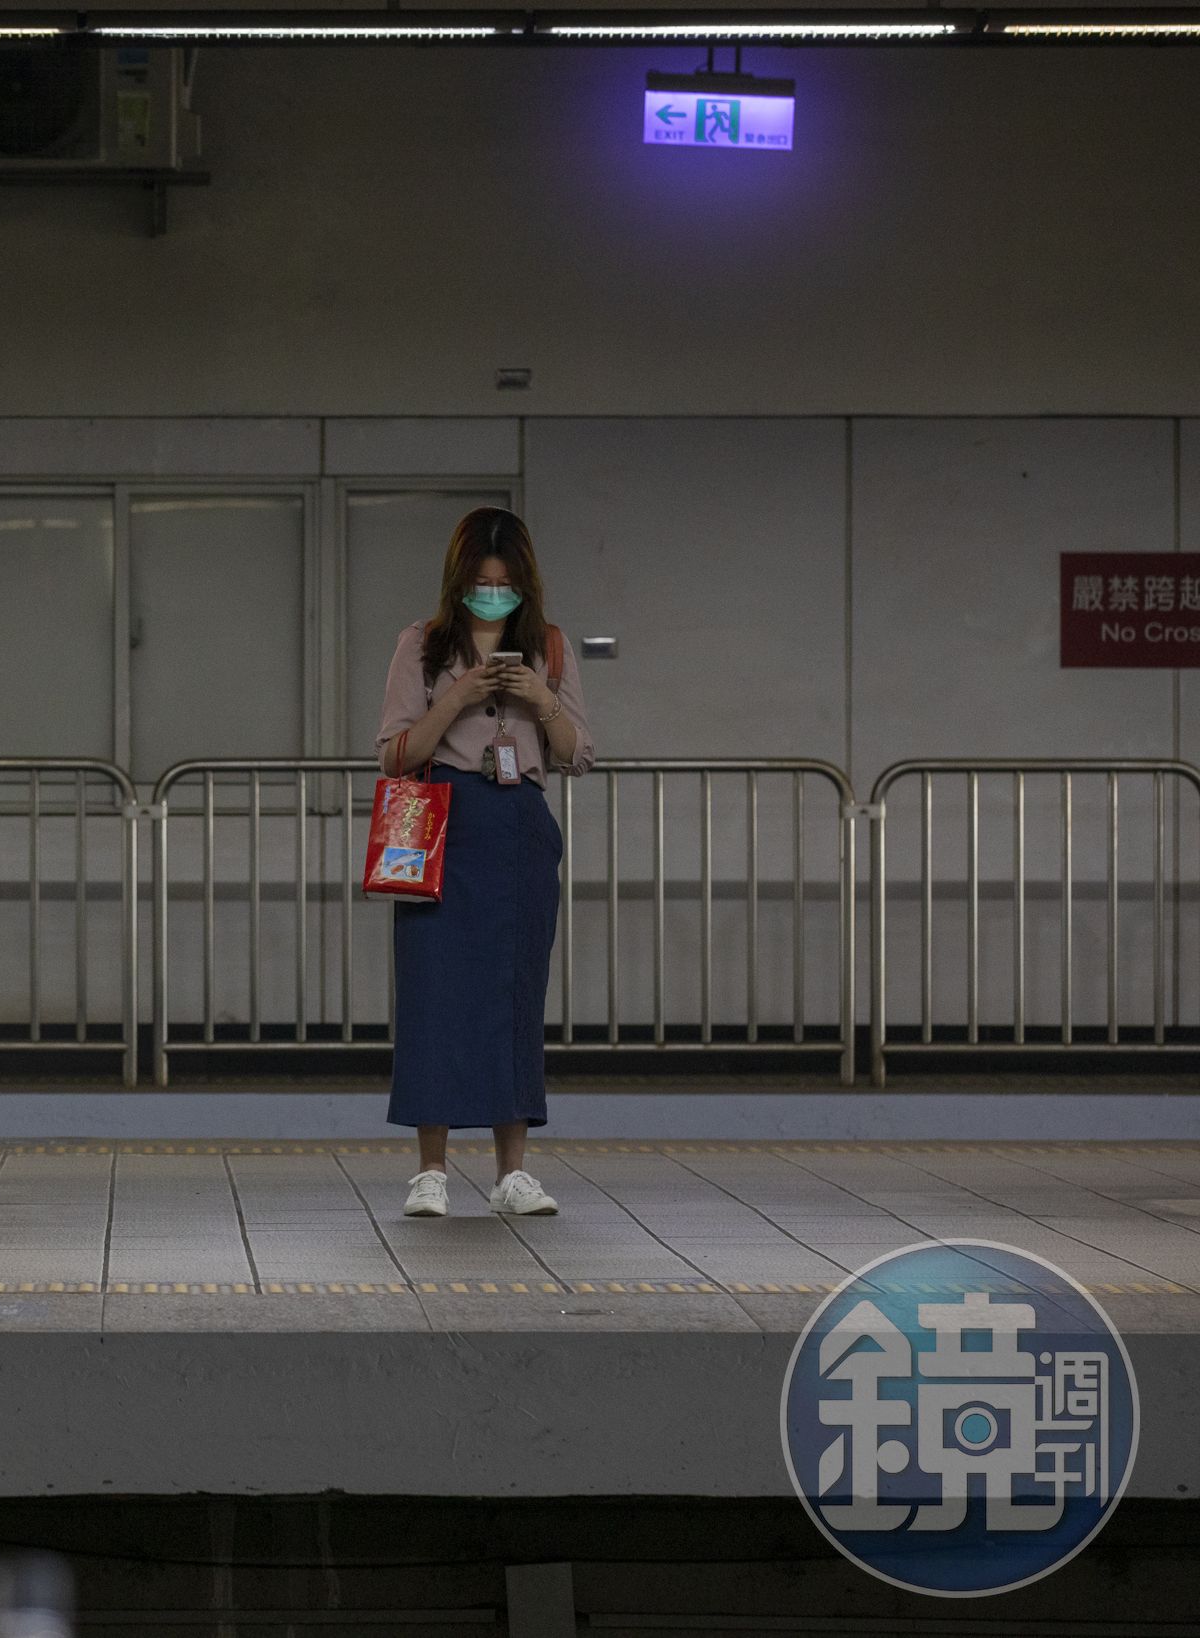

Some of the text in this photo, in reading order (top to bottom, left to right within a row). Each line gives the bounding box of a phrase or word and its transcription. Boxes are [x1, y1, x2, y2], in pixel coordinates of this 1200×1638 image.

[654, 130, 685, 141] EXIT
[1101, 621, 1200, 643] No Cros
